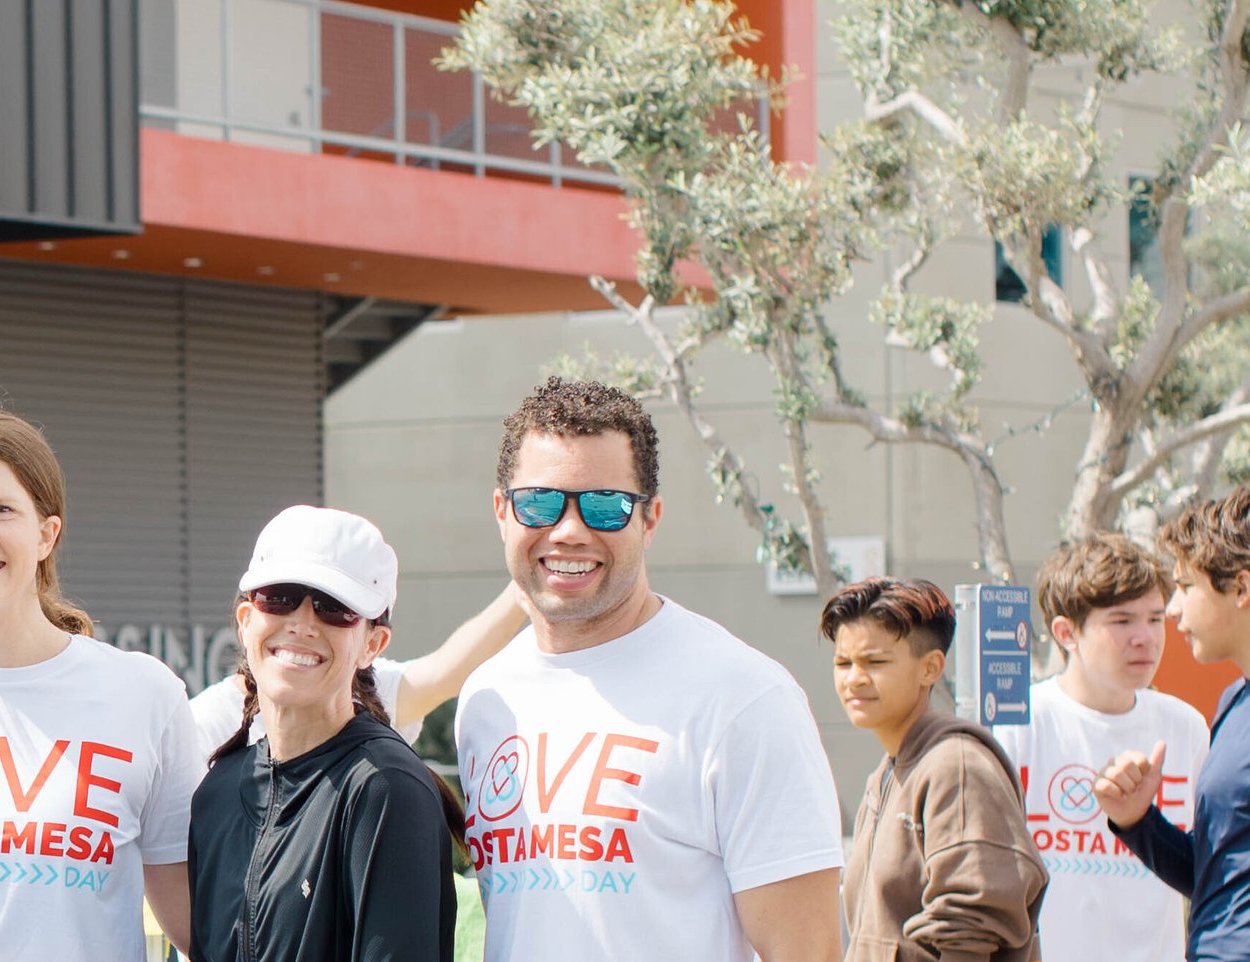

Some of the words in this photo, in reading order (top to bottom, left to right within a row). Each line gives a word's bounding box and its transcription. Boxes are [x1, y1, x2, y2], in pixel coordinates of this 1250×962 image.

[0, 821, 117, 865] MESA
[467, 826, 527, 872] OSTA
[529, 824, 635, 864] MESA
[1032, 829, 1108, 856] OSTA
[65, 866, 110, 892] DAY
[581, 870, 637, 894] DAY
